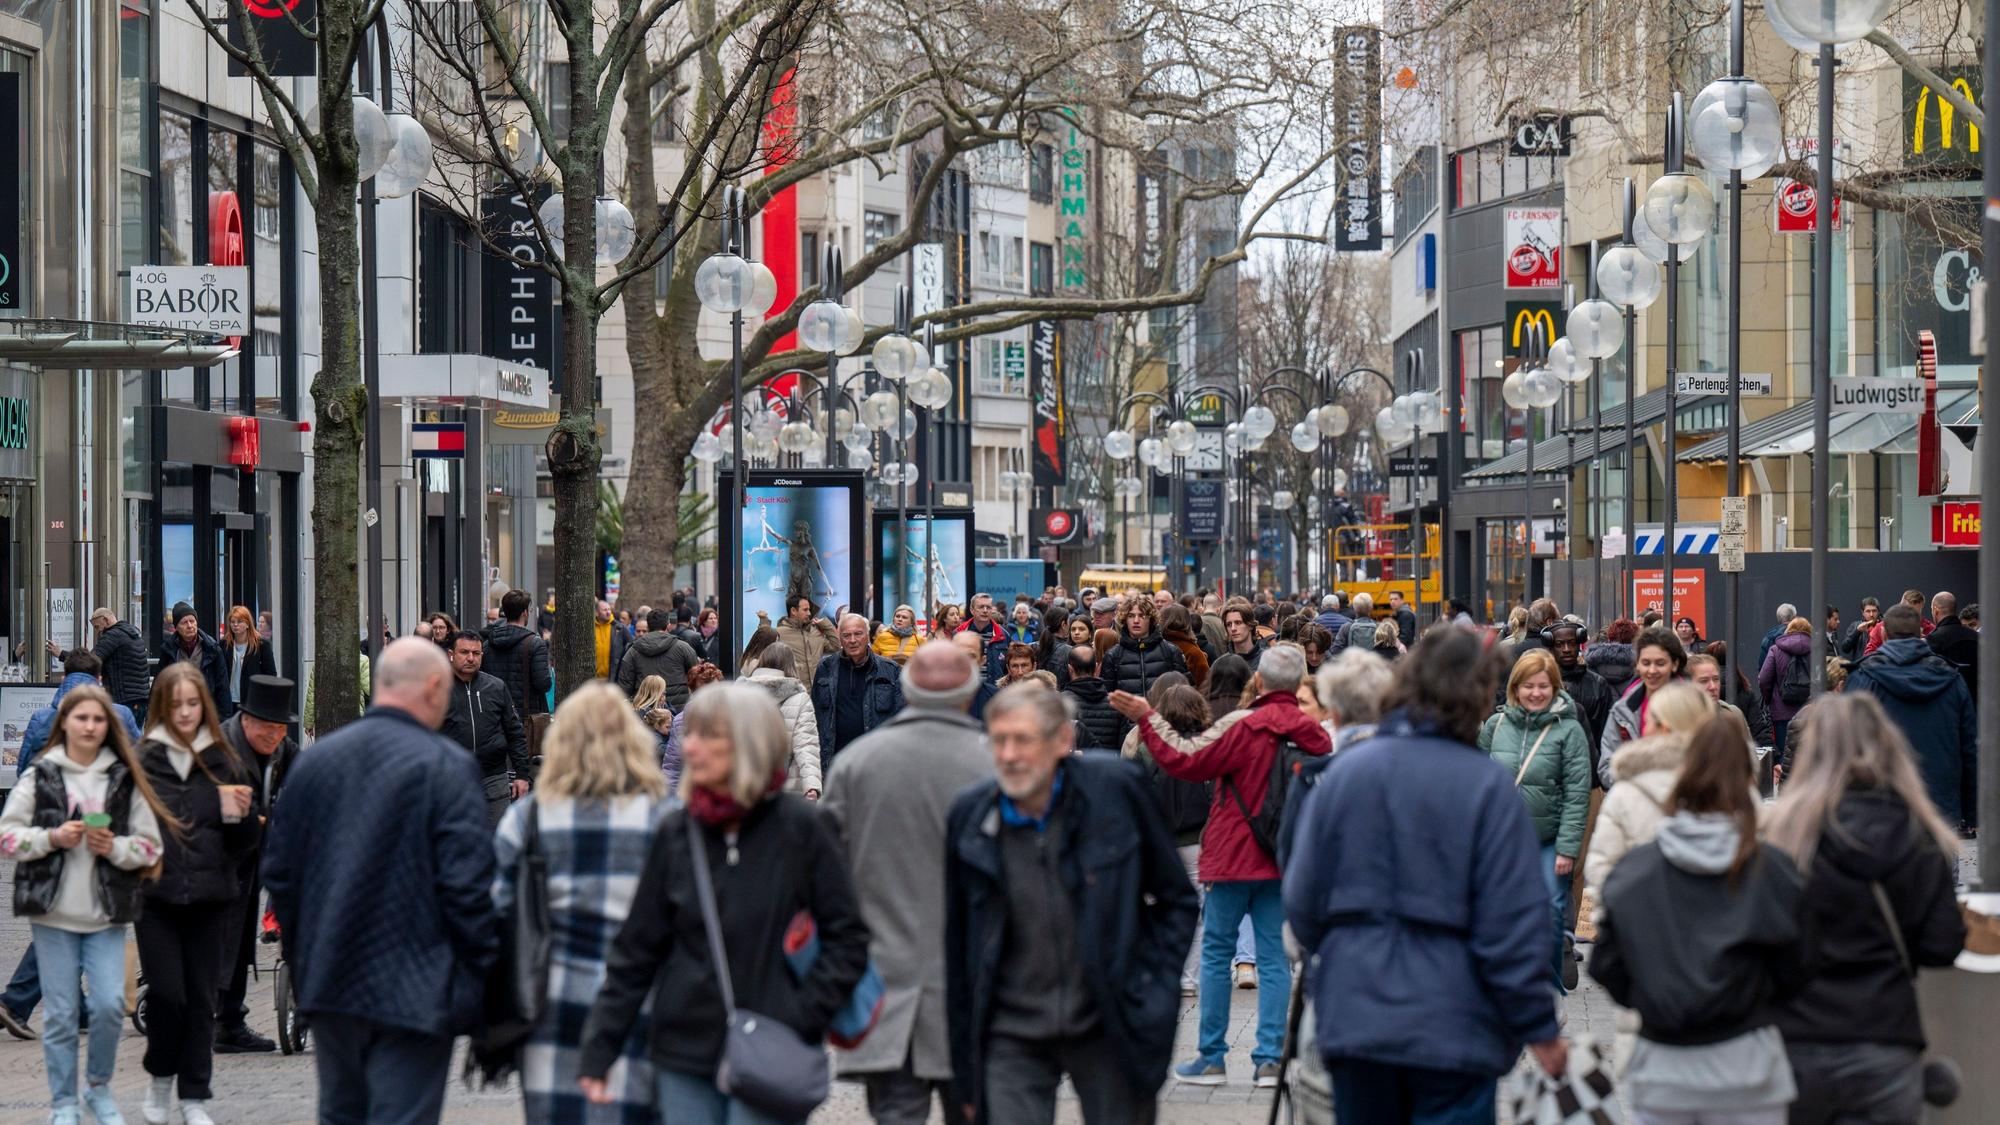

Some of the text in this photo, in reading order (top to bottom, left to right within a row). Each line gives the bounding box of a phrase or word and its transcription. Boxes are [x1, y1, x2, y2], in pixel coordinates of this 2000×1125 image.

[1517, 123, 1563, 150] C&A
[136, 273, 167, 284] 4.OG
[136, 287, 242, 314] BABOR
[209, 320, 242, 330] SPA
[1833, 383, 1925, 409] Ludwigstr.
[1641, 588, 1657, 596] NEU
